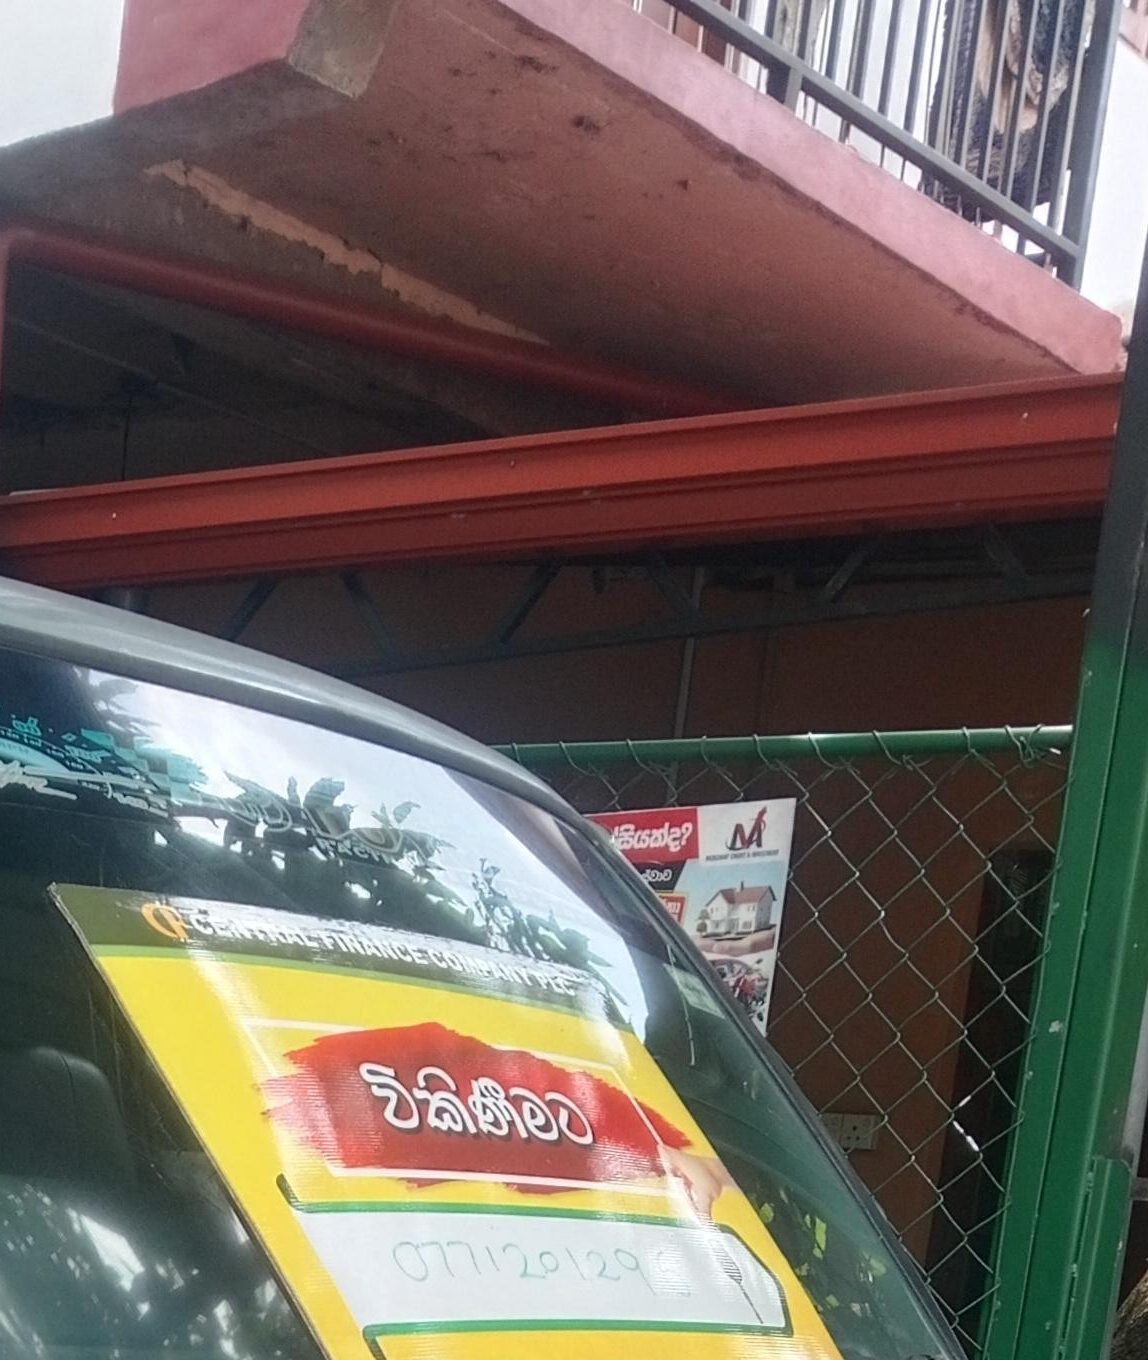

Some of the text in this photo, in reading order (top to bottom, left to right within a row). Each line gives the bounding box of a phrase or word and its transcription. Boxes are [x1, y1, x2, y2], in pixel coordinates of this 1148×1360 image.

[188, 914, 319, 949] CENTRAL
[319, 927, 428, 966] FINANCE
[427, 948, 534, 987] COMPANY
[530, 968, 577, 998] PLC
